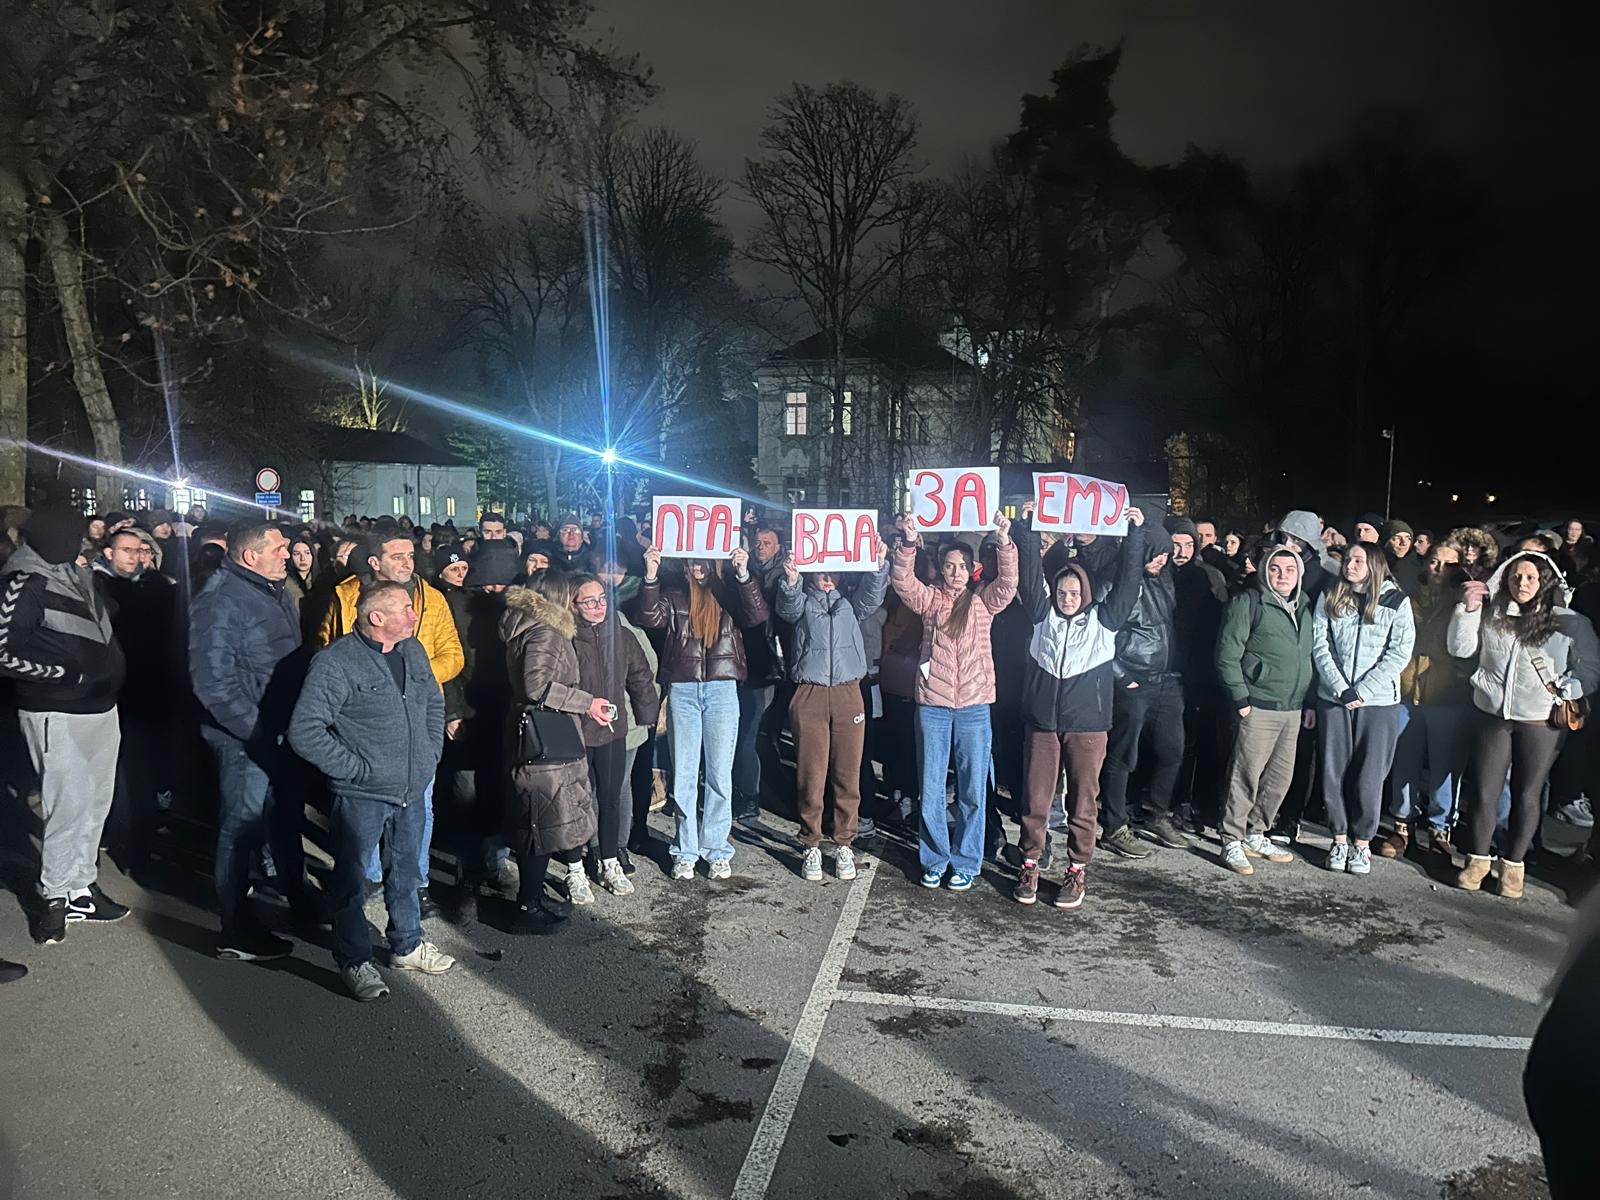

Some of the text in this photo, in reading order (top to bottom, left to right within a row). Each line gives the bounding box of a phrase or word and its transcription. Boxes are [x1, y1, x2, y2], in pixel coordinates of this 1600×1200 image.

[915, 472, 987, 526] ЗА
[1037, 476, 1125, 526] ЕМУ
[656, 504, 740, 551] ПРА-
[795, 513, 876, 564] ВДА
